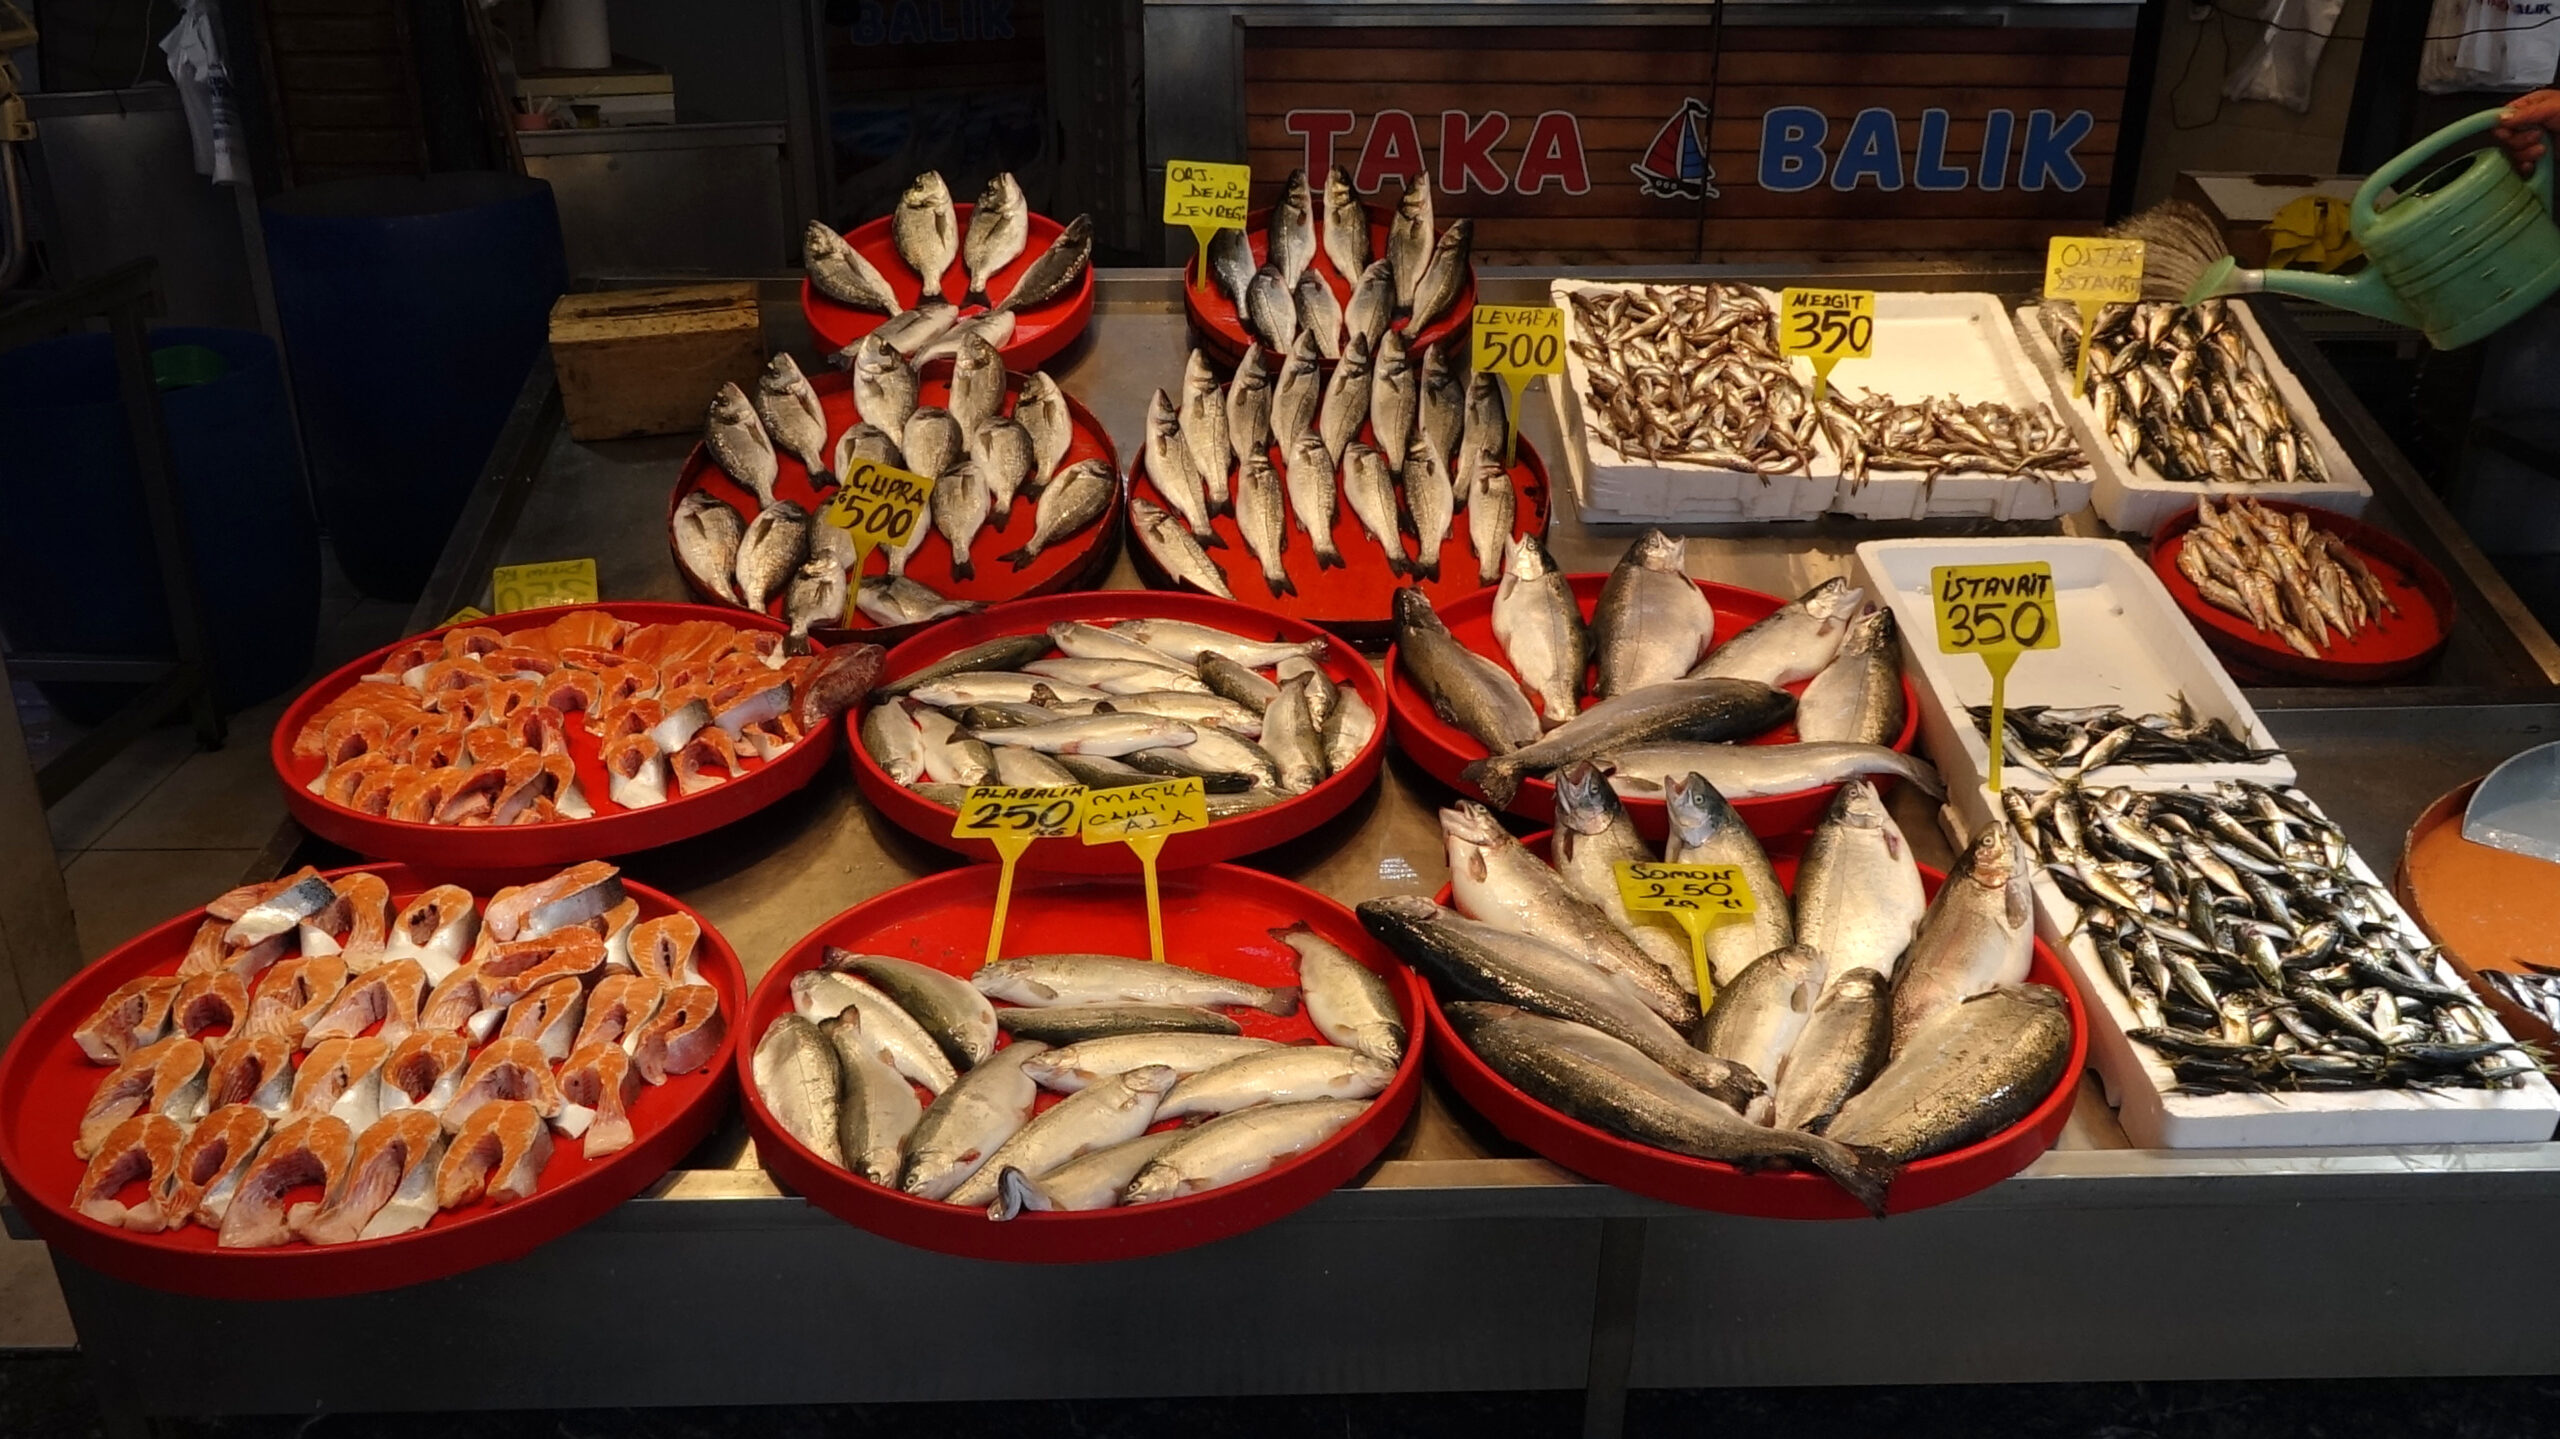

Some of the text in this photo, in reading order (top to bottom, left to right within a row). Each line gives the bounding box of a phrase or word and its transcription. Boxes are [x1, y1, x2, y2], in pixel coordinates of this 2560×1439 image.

[1285, 106, 2094, 195] TAKA BALIK
[1483, 331, 1558, 371] 500
[1789, 310, 1873, 354] 350
[839, 495, 913, 539] 500
[1948, 601, 2046, 648] 350
[972, 786, 1085, 800] ALABALIK
[966, 799, 1075, 830] 250
[1630, 864, 1736, 881] SOMON
[1638, 882, 1733, 899] 250
